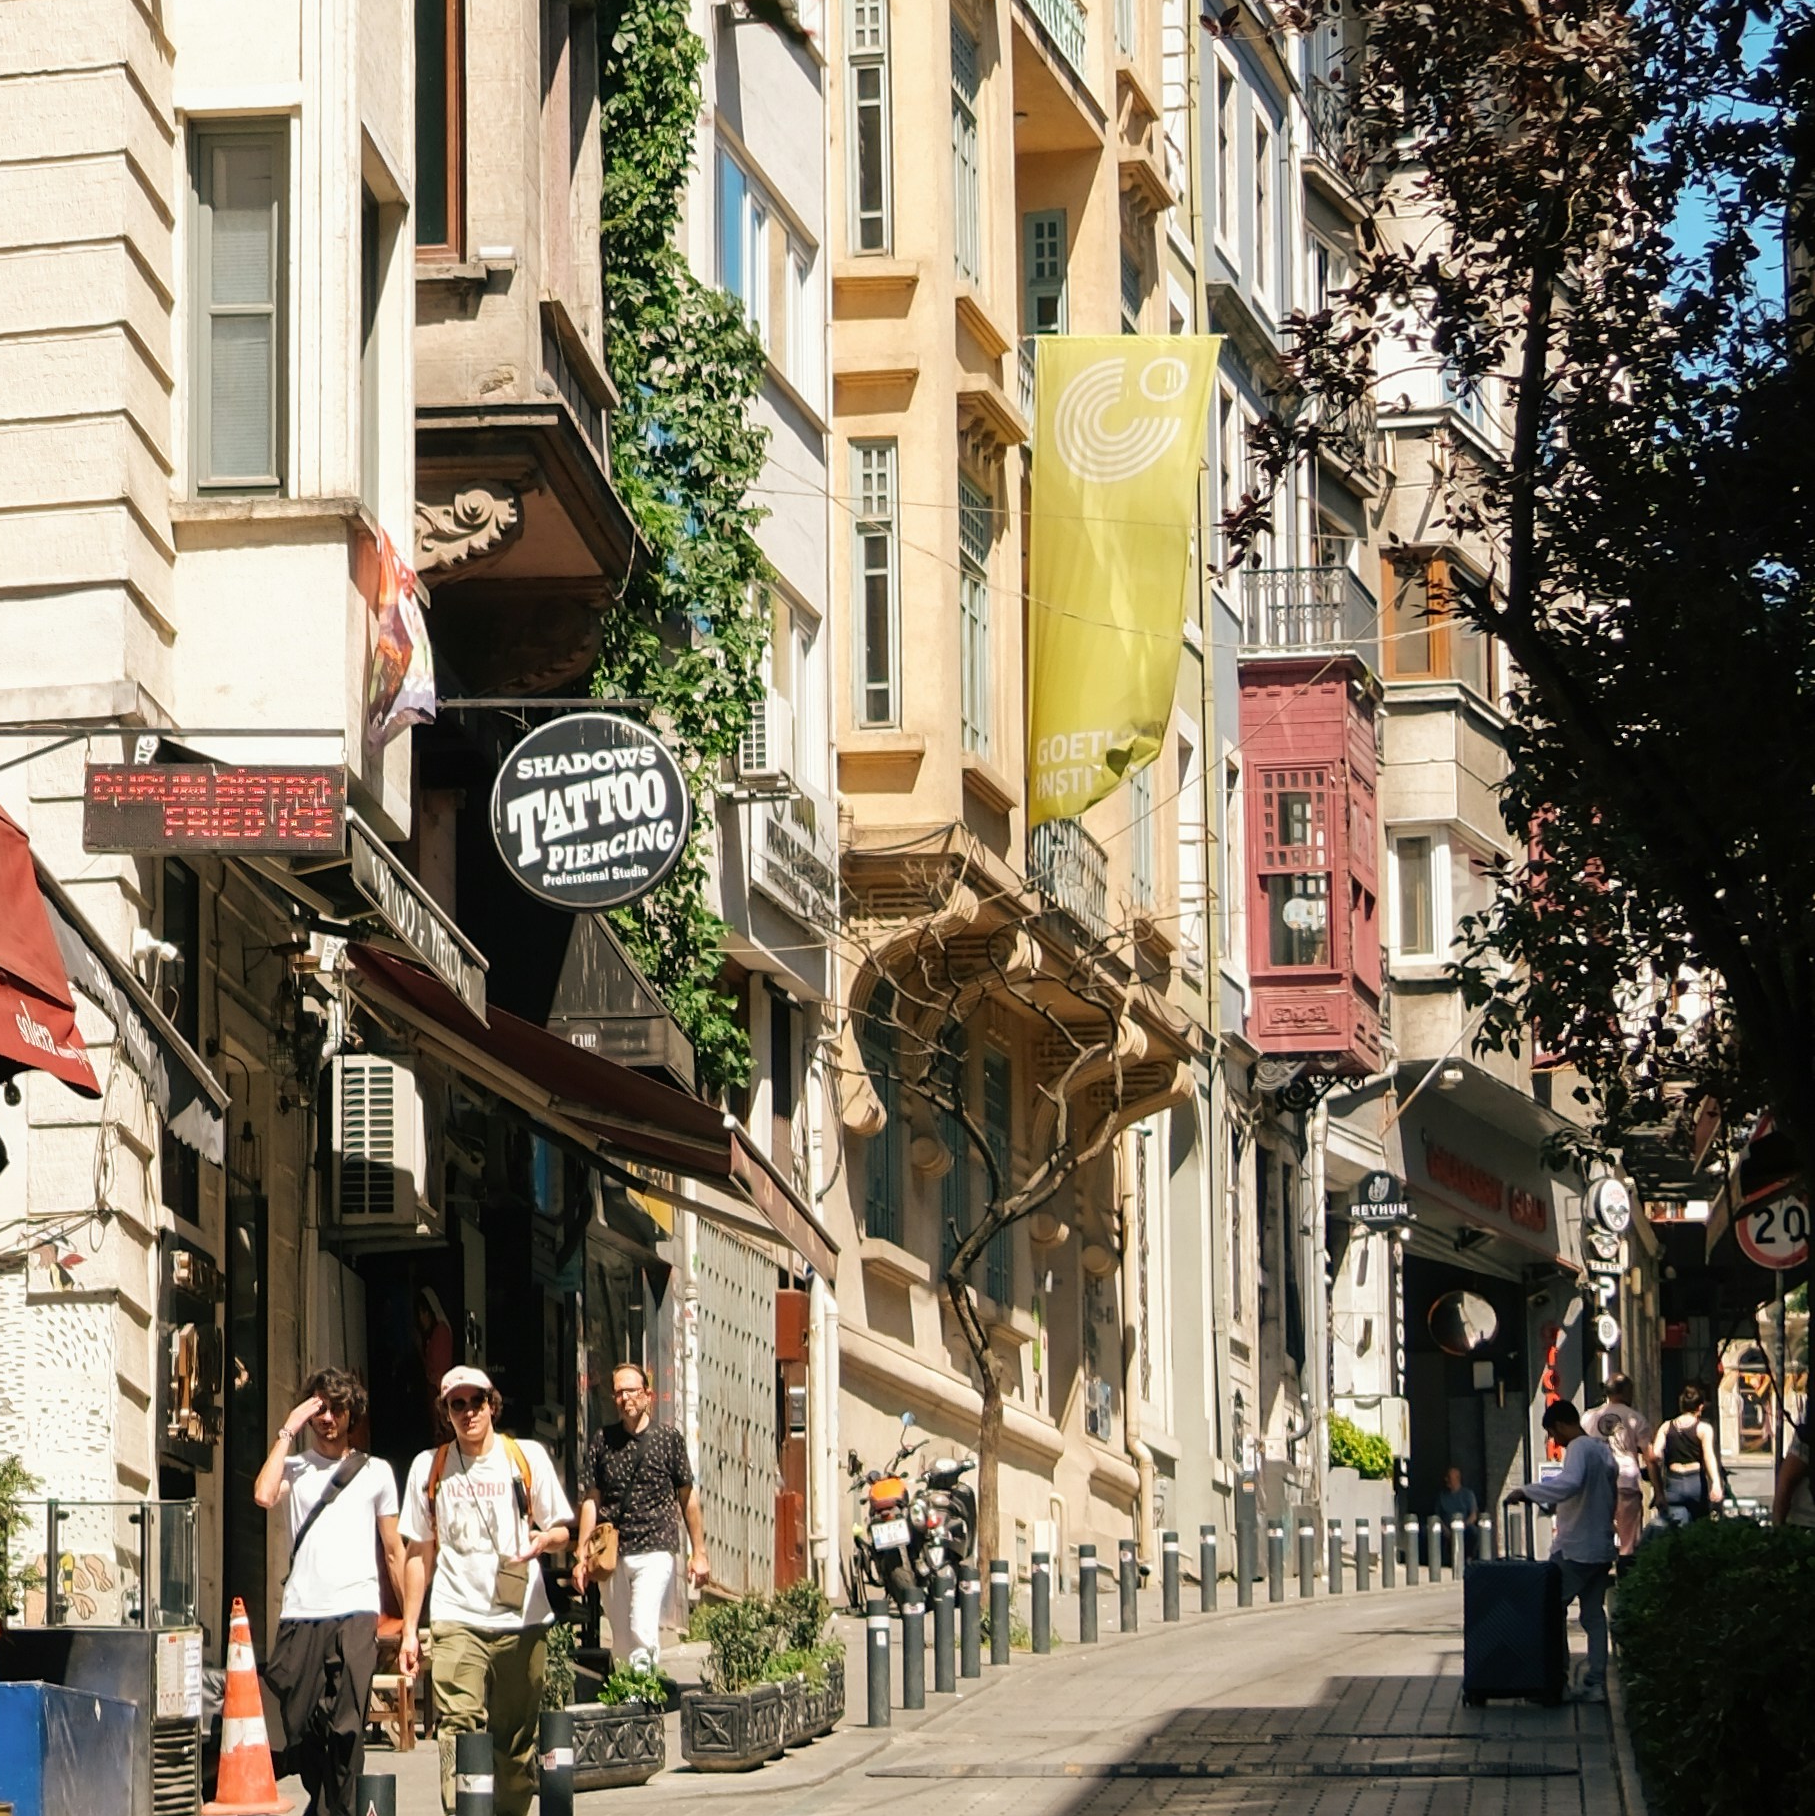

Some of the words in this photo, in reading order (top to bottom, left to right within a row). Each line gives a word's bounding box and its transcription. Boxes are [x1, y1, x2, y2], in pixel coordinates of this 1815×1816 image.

[517, 746, 657, 780] SHADOWS
[507, 768, 667, 868] TATTOO
[547, 819, 676, 871] PIERCING
[542, 868, 609, 887] Professional
[612, 864, 649, 880] Studio
[1754, 1205, 1807, 1243] 20
